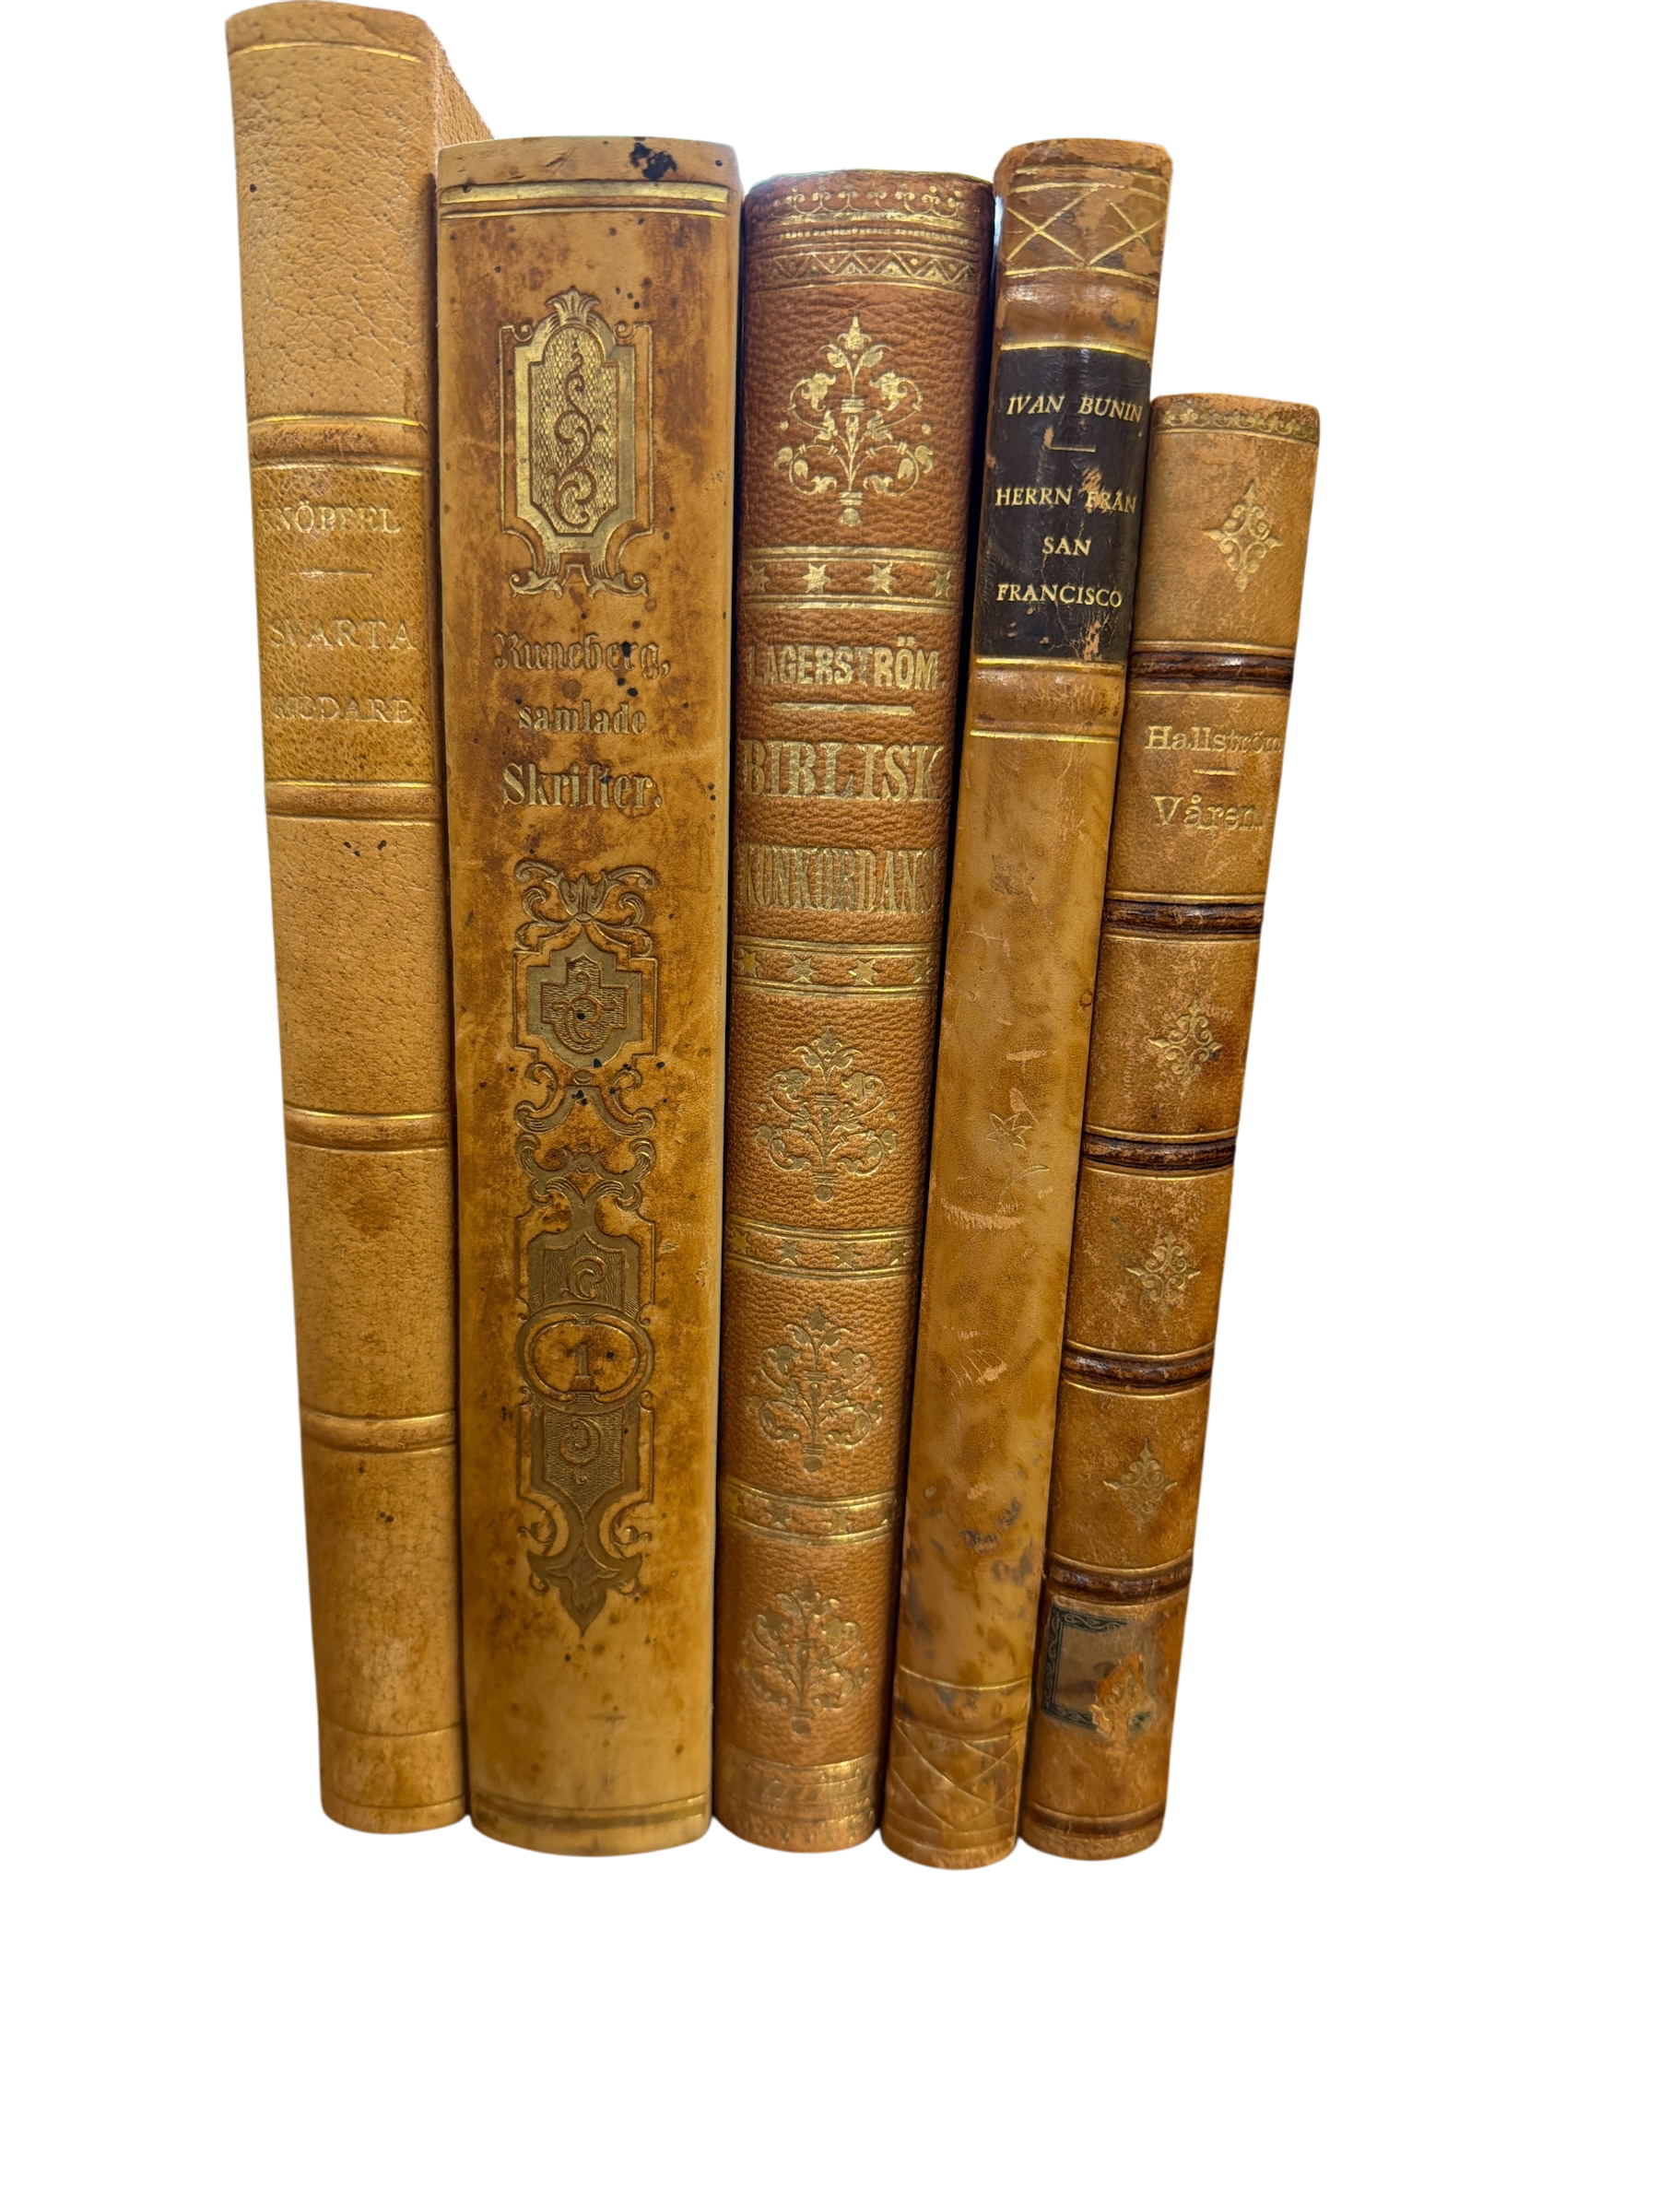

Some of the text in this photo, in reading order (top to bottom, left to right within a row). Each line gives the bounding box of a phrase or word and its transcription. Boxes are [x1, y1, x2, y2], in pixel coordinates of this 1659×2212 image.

[1006, 394, 1143, 423] IVAN BUNIN
[994, 487, 1137, 514] HERRN FRÅN
[1041, 536, 1092, 556] SAN
[996, 582, 1124, 608] FRANCISCO
[269, 618, 418, 651] SVARTA
[493, 632, 671, 680] Runeberg,
[518, 699, 647, 736] samlade
[1144, 724, 1284, 753] Hallström
[502, 762, 664, 809] Skrifter.
[739, 738, 945, 803] BIBLISK
[1150, 793, 1264, 830] Våren
[565, 1342, 594, 1381] 1
